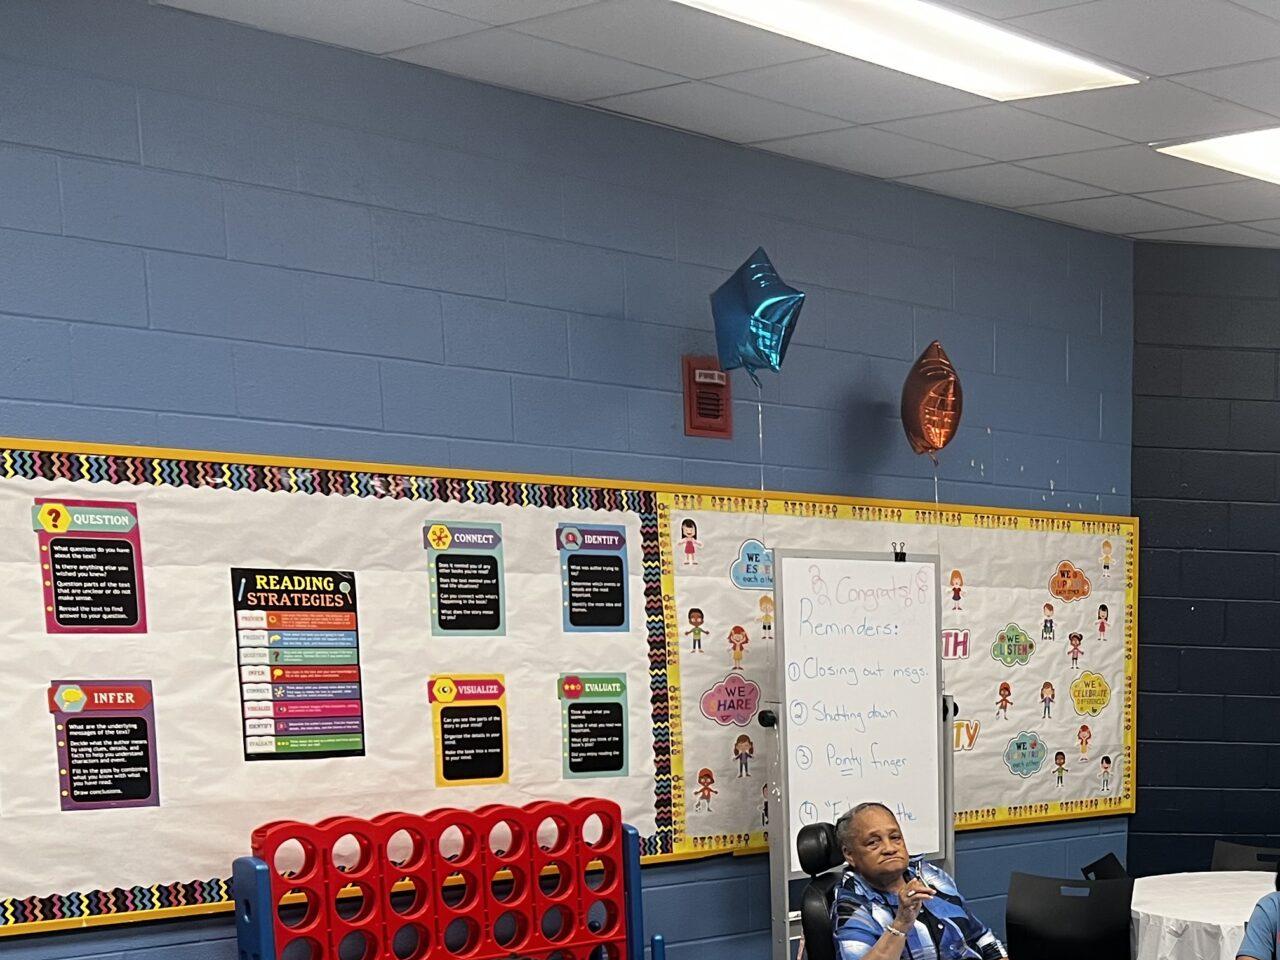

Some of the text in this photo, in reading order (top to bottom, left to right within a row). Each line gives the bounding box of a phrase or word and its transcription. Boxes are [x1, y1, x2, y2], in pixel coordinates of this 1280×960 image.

[74, 514, 129, 525] QUESTION
[454, 534, 494, 543] CONNECT
[584, 535, 619, 545] IDENTIFY
[255, 575, 334, 591] READING
[247, 592, 344, 607] STRATEGIES
[799, 597, 899, 637] Reminders:
[1007, 635, 1019, 643] WE
[1000, 644, 1027, 655] LISTEN
[803, 656, 859, 686] Closing
[863, 660, 884, 677] out
[458, 685, 498, 694] VISUALIZE
[725, 687, 745, 697] WE
[93, 692, 135, 704] INFER
[812, 700, 866, 733] Shutting
[868, 704, 899, 719] down
[871, 742, 907, 776] finger
